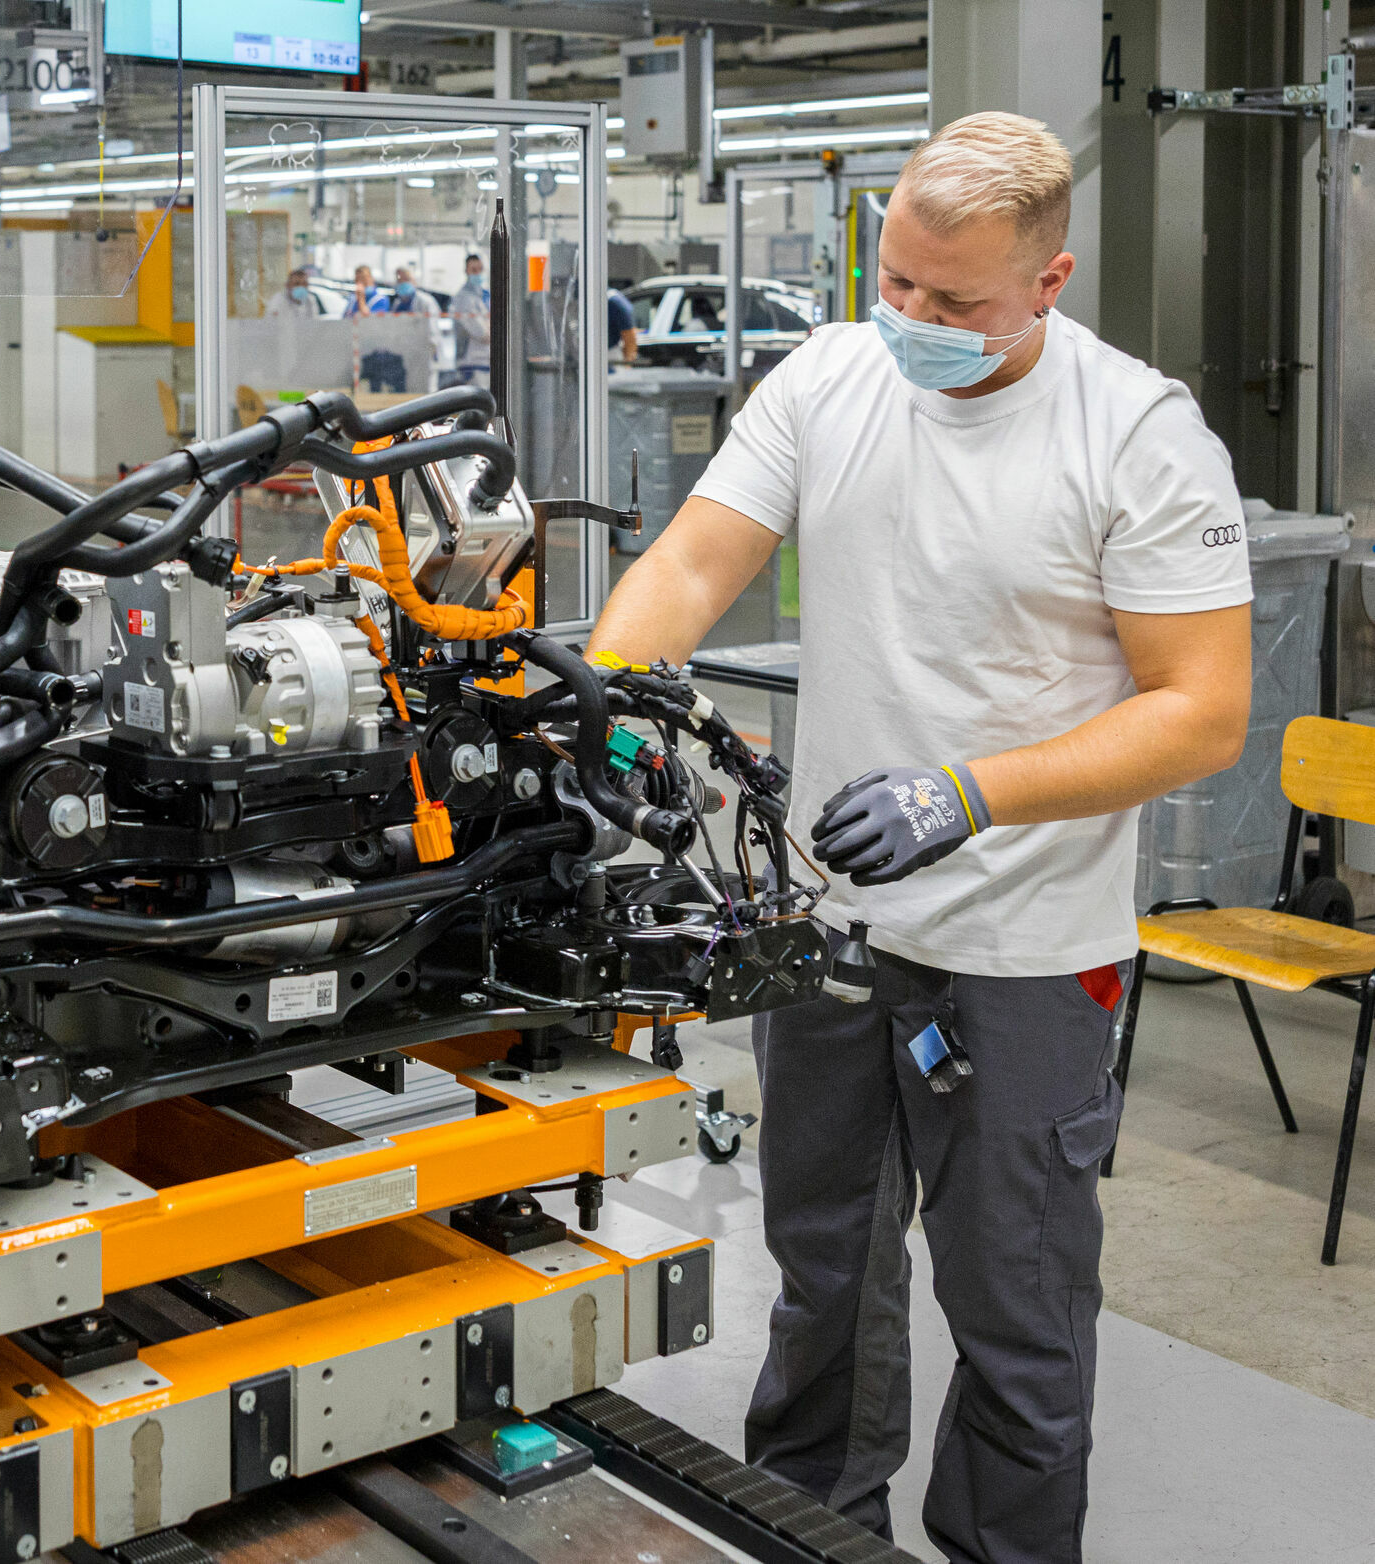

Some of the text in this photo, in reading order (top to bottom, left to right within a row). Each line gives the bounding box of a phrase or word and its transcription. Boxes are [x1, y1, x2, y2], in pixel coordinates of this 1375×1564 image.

[397, 63, 430, 85] 162
[1102, 35, 1125, 102] 4
[887, 785, 926, 842] MaxiFlex
